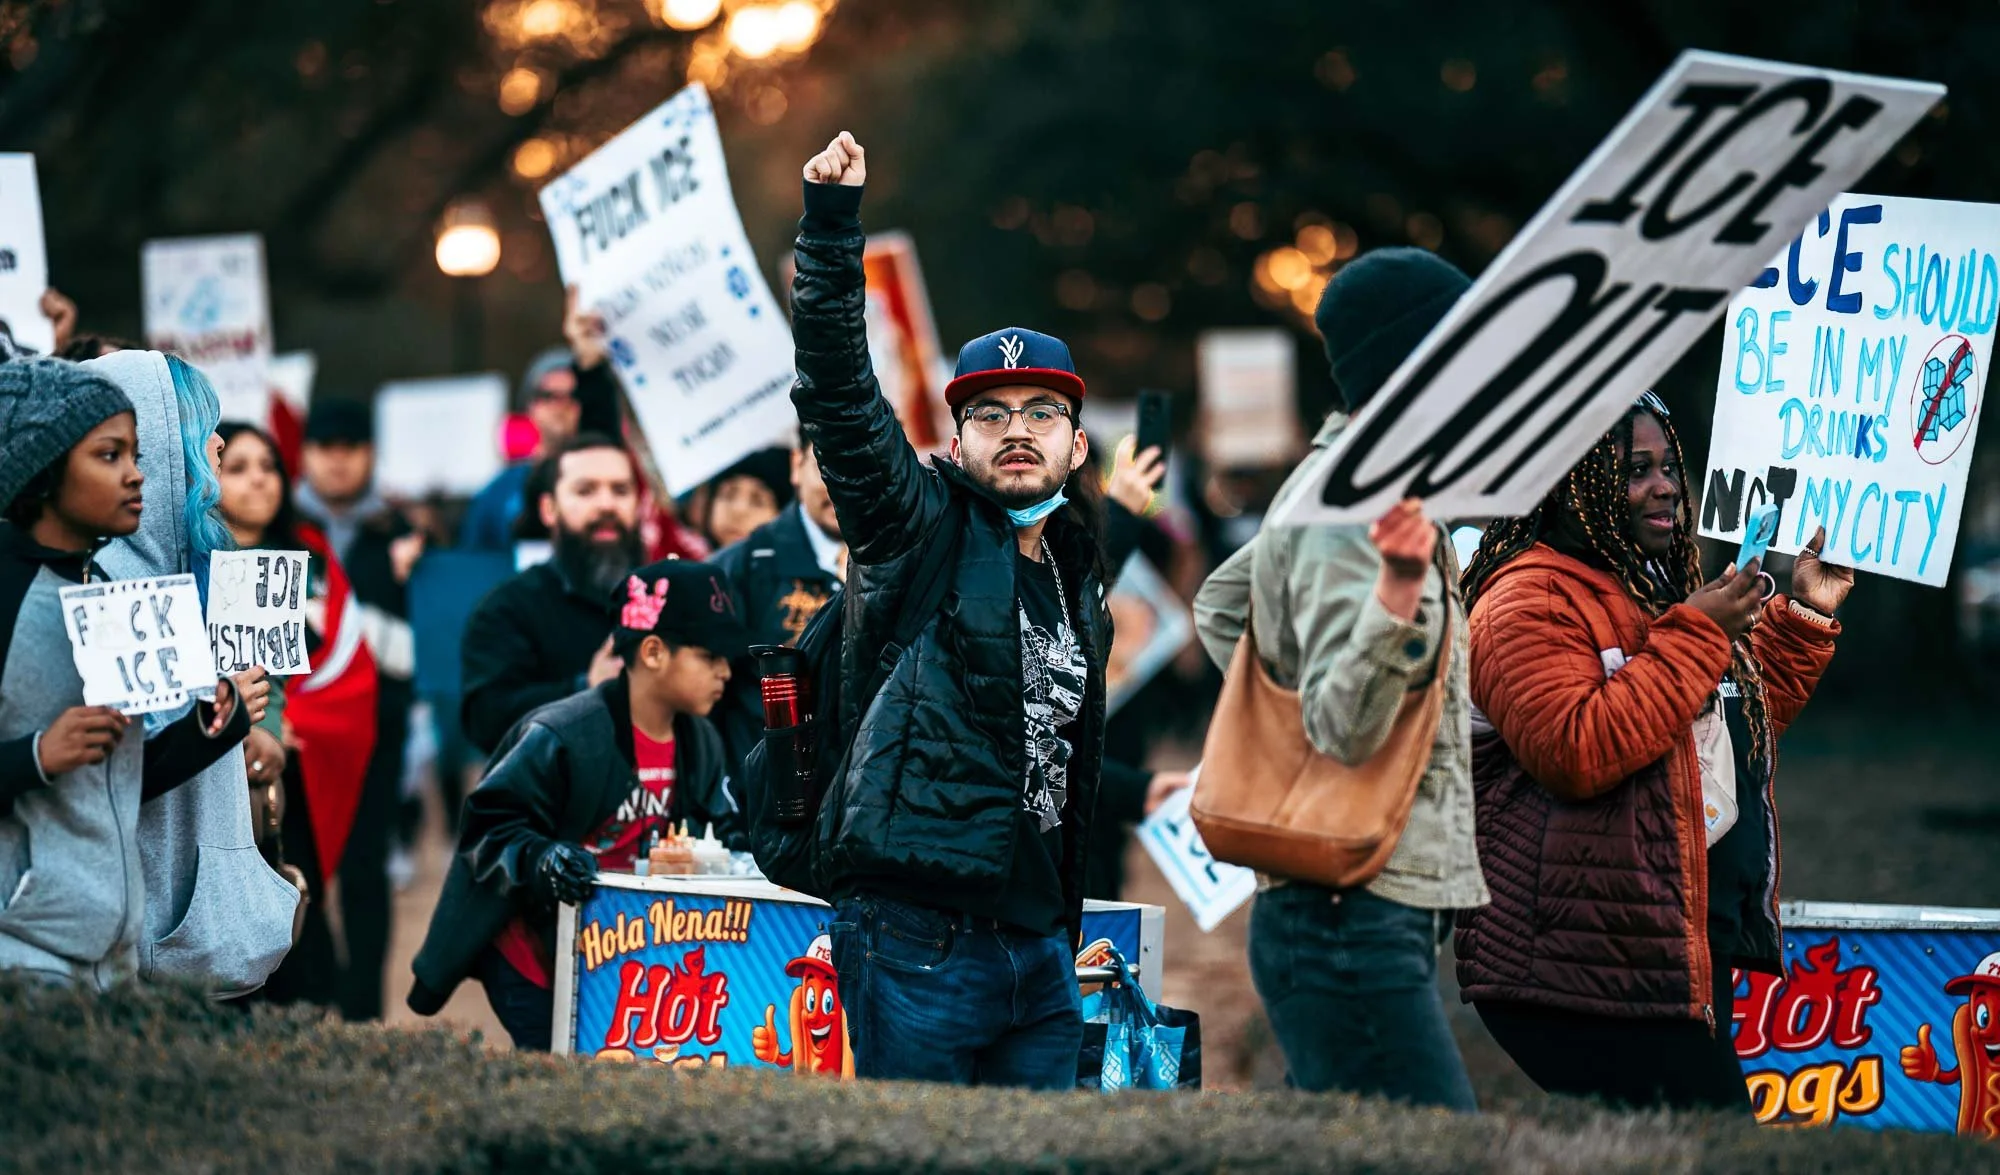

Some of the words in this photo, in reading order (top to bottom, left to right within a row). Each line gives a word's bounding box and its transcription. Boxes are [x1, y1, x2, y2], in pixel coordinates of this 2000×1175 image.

[1568, 77, 1884, 245] ICE
[574, 170, 651, 265] FUCK
[1746, 203, 1883, 314] CE
[1874, 242, 1999, 335] SHOULD
[1321, 249, 1731, 509] OUT
[1735, 307, 1792, 395] BE
[1809, 325, 1844, 398] IN
[1856, 334, 1907, 417] MY
[1778, 397, 1890, 463] DRINKS
[1702, 465, 1797, 548] NOT
[1795, 476, 1852, 549] MY
[1851, 482, 1947, 576] CITY
[72, 594, 176, 647] FCK
[256, 555, 301, 610] ICE
[116, 646, 182, 695] ICE
[208, 620, 301, 672] ABOLISH
[579, 911, 647, 972] Hola
[649, 897, 752, 945] Nena!!!
[604, 945, 730, 1049] Hot
[1746, 1054, 1884, 1129] ogs
